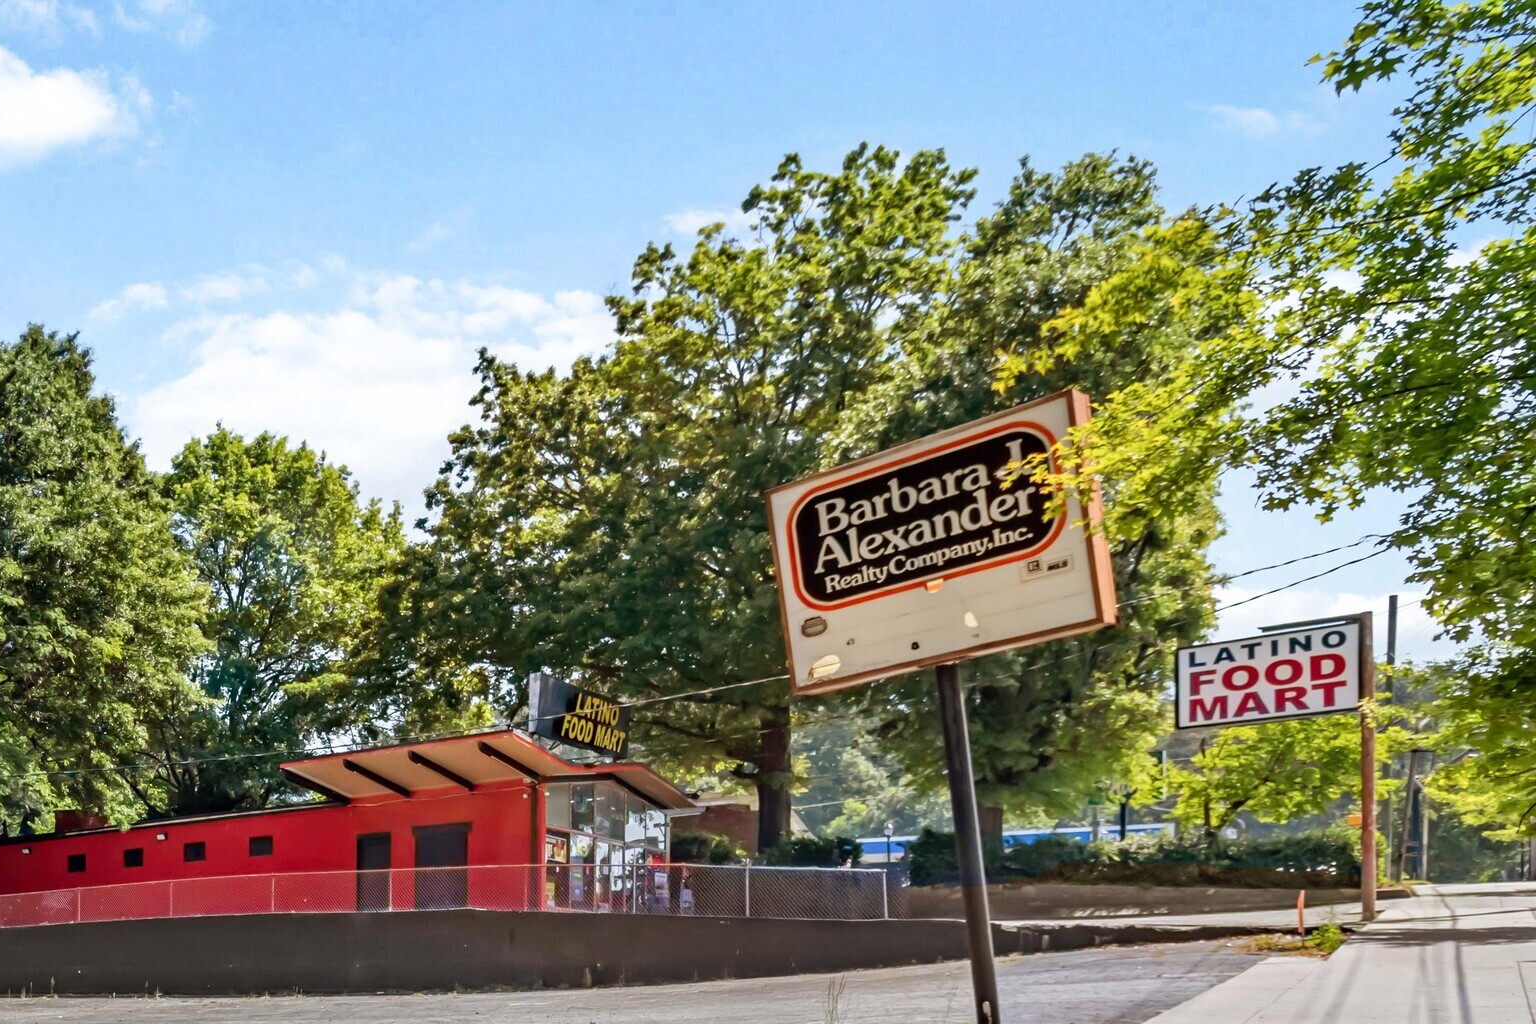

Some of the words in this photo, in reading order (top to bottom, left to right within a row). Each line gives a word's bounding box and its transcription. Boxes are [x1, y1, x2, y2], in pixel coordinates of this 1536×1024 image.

[815, 463, 991, 537] Barbara
[814, 486, 1036, 574] Alexander
[825, 565, 890, 594] Realty
[1189, 630, 1347, 668] LATINO
[1189, 653, 1346, 696] FOOD
[575, 692, 620, 726] LATINO
[1189, 680, 1347, 722] MART
[561, 714, 594, 743] FOOD
[593, 724, 626, 753] MART
